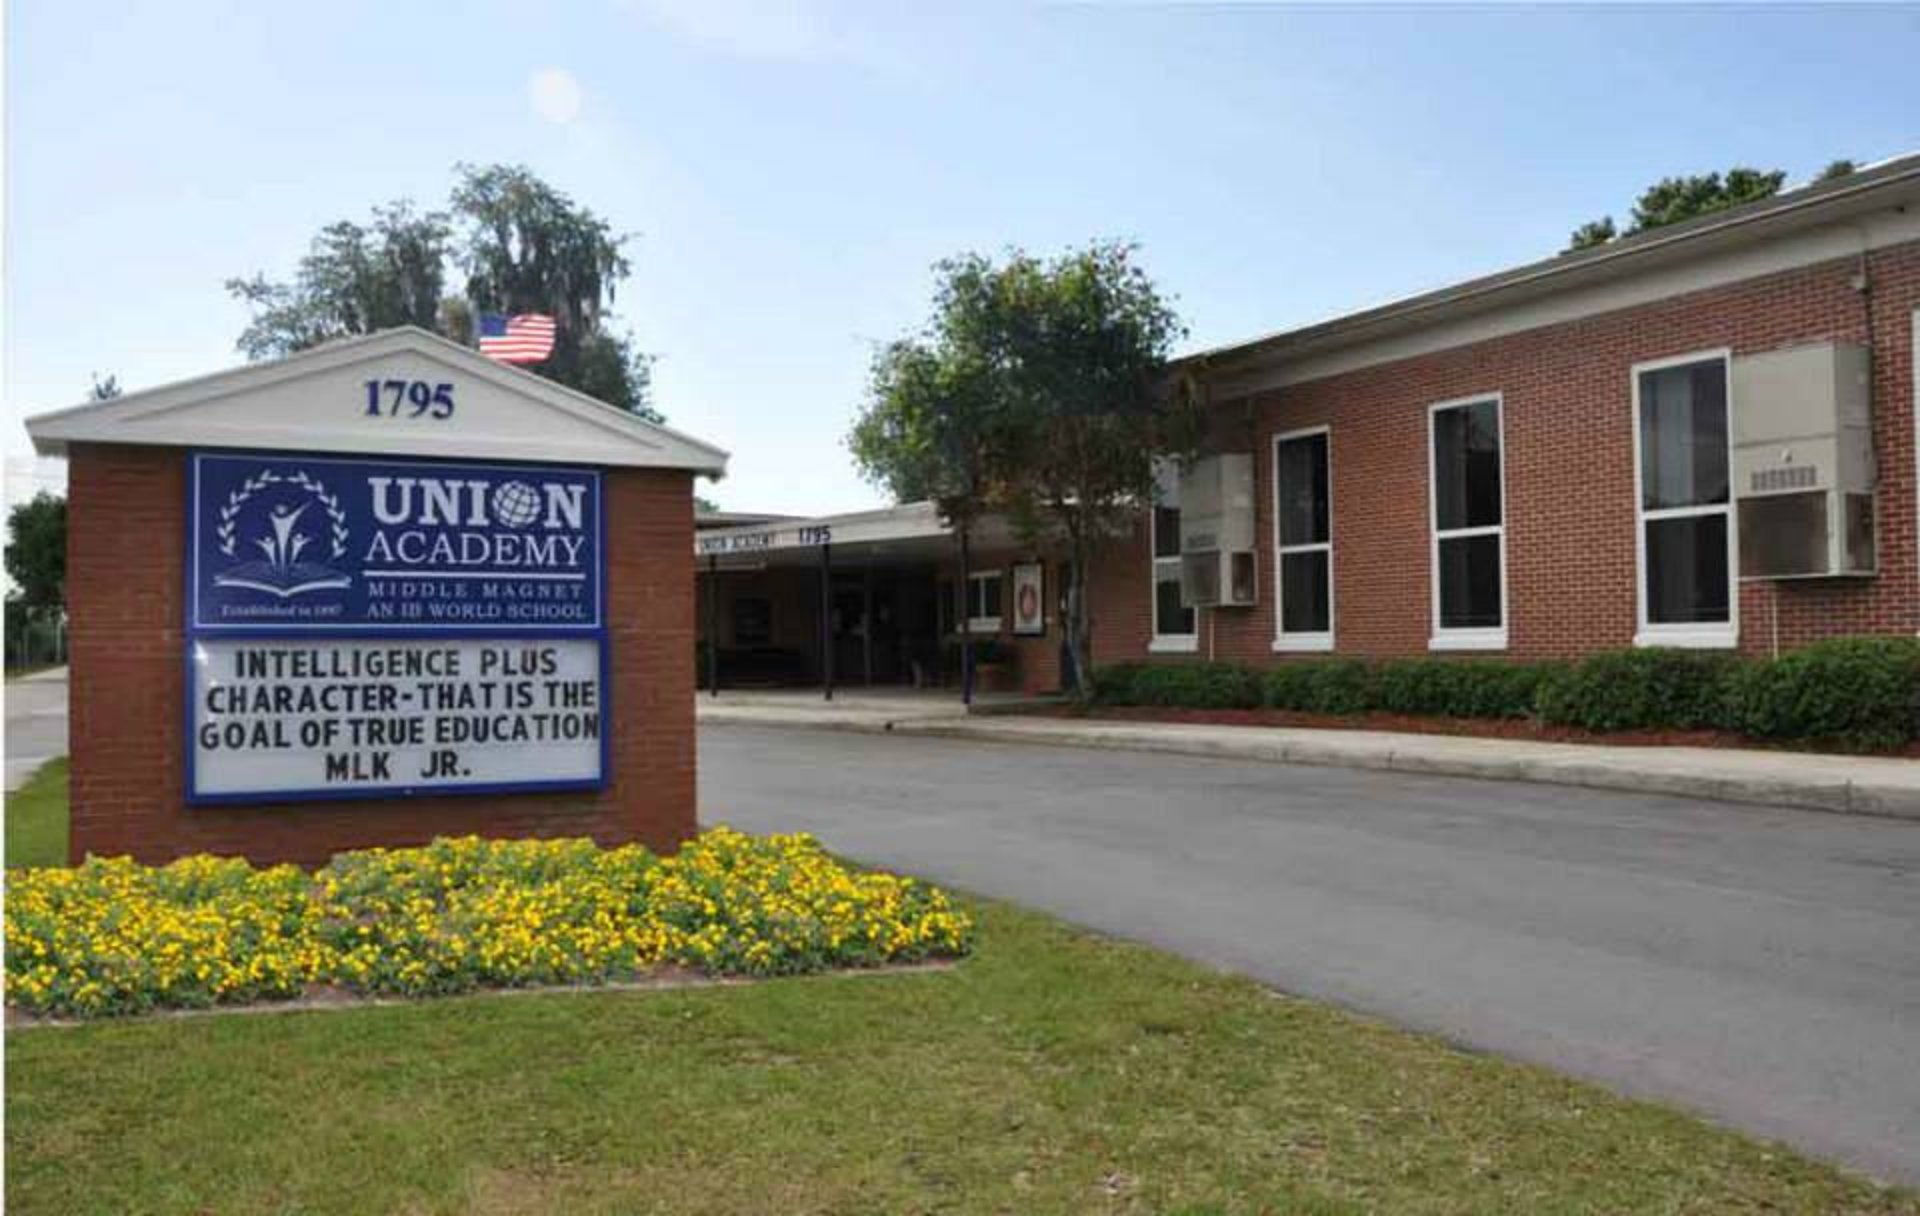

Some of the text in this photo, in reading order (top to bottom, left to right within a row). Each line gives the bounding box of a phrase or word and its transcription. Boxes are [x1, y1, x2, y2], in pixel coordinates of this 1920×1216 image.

[365, 379, 455, 421] 1795
[368, 477, 586, 529] UNION
[363, 531, 585, 567] ACADEMY
[800, 525, 832, 544] 1795
[368, 582, 583, 598] MIDDLE MAGNET
[368, 603, 394, 617] AN
[429, 604, 500, 618] WORLD
[507, 604, 587, 618] SCHOOL
[235, 648, 558, 678] INTELLIGENCE PLUS
[506, 683, 533, 709] IS
[543, 681, 595, 708] THE
[199, 713, 598, 750] GOAL OF TRUE EDUCATION
[325, 752, 470, 781] MLK JR.
